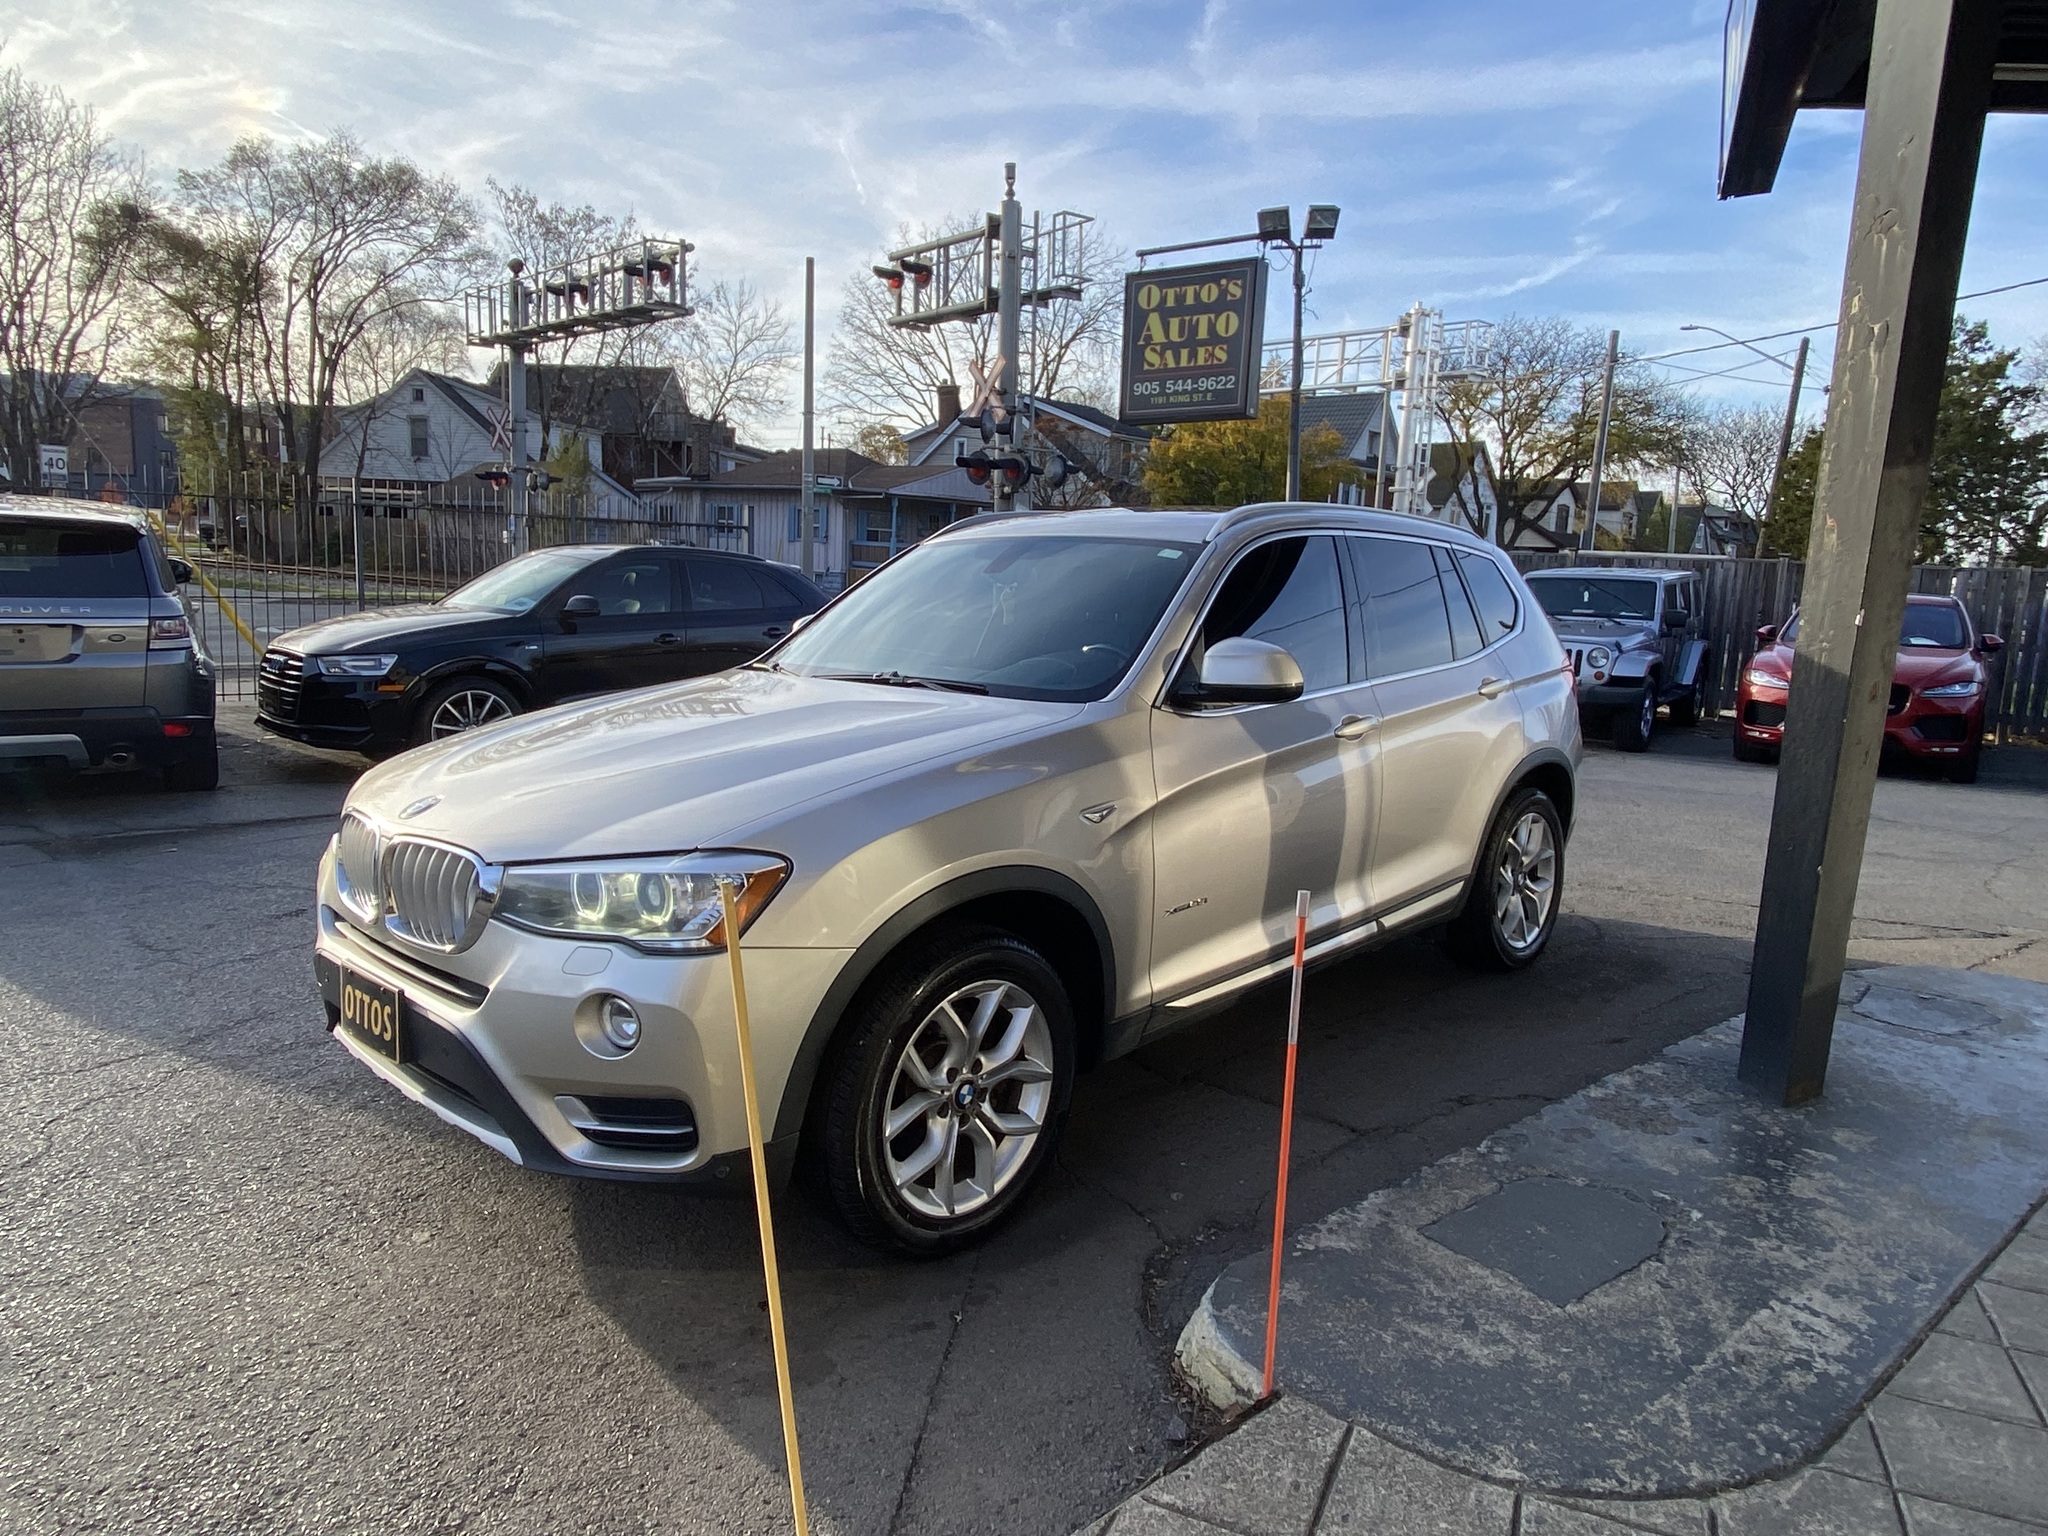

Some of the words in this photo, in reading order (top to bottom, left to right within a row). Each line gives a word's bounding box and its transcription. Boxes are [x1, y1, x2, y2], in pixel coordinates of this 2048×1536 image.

[1137, 278, 1243, 310] OTTO'S
[1137, 311, 1239, 345] AUTO
[1143, 344, 1228, 371] SALES
[1133, 381, 1160, 396] 905
[1165, 375, 1236, 393] 544-9622
[1169, 393, 1190, 403] KING
[44, 457, 66, 470] 40
[0, 606, 92, 614] ROVER
[344, 984, 392, 1041] OTTOS
